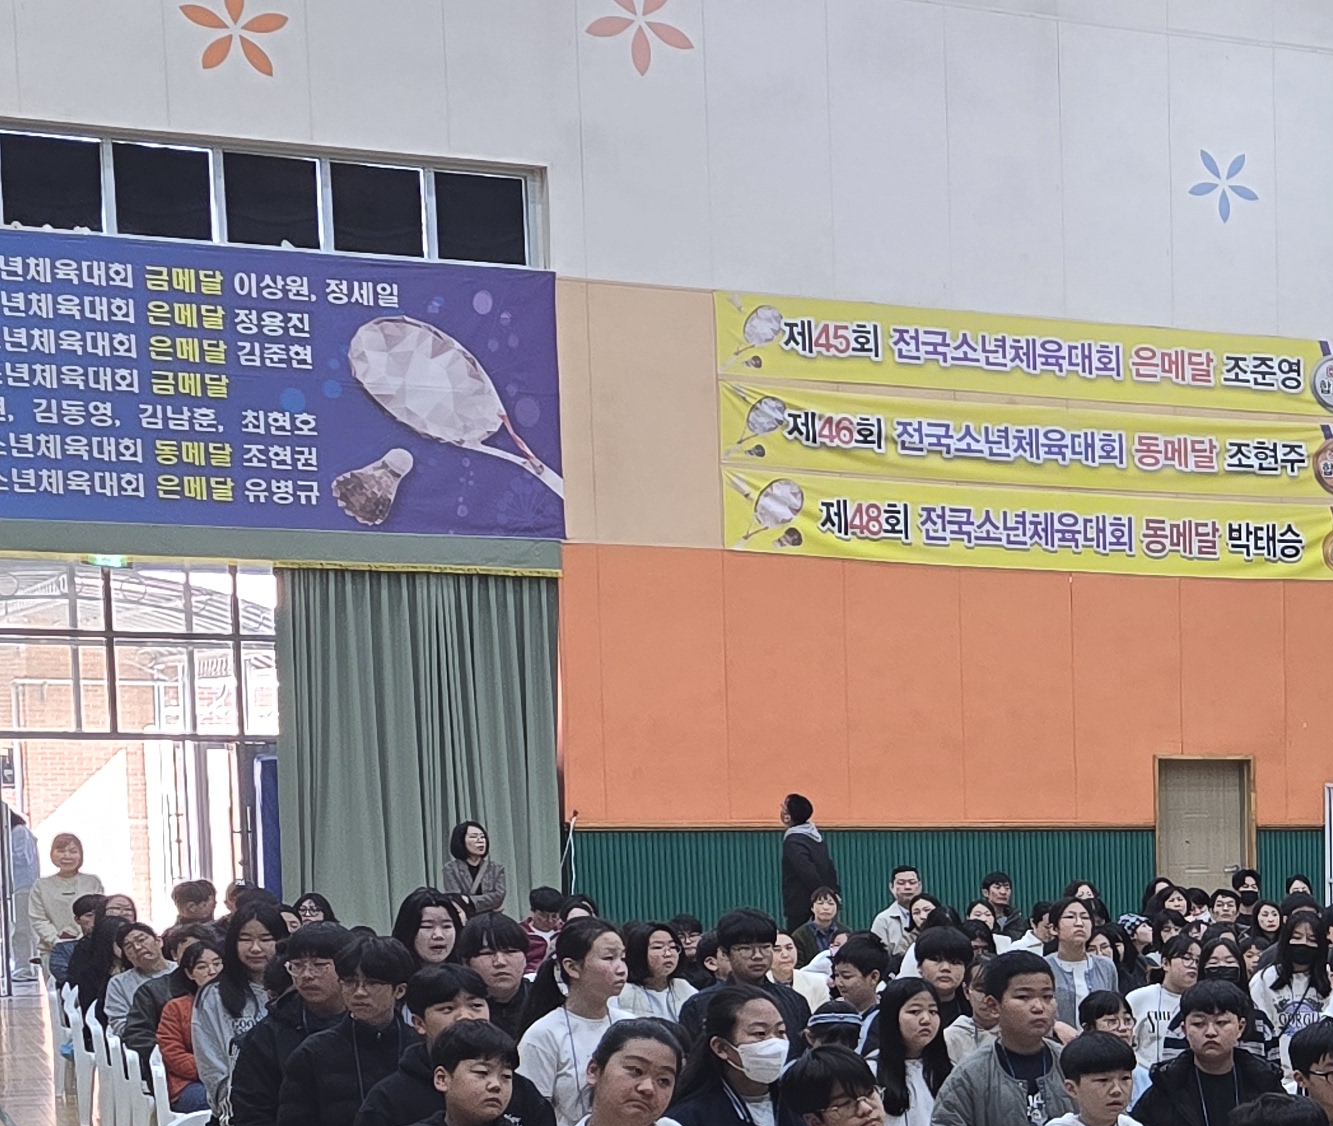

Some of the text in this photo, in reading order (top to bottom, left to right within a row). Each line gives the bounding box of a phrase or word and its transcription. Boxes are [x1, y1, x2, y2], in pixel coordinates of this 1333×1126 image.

[145, 264, 224, 296] 금메달
[233, 272, 317, 302] 이상원,
[325, 279, 399, 308] 정세일
[147, 300, 226, 330] 은메달
[234, 308, 311, 338] 정용진
[0, 326, 313, 370] 년체육대회 은메달 김준현
[783, 319, 1303, 390] 제45회 전국소년체육대회 은메달 조준영
[0, 362, 230, 398] 년체육대회 금메달
[33, 398, 121, 428] 김동영,
[138, 403, 224, 433] 김남훈,
[241, 409, 318, 436] 최현호
[154, 439, 233, 467] 동메달
[243, 443, 318, 471] 조현권
[787, 411, 1307, 476] 제46회 전국소년체육대회 동메달 조현주
[157, 474, 235, 502] 은메달
[244, 478, 320, 505] 유병규
[819, 499, 1303, 560] 제48회 전국소년체육대회 동메달 박태승
